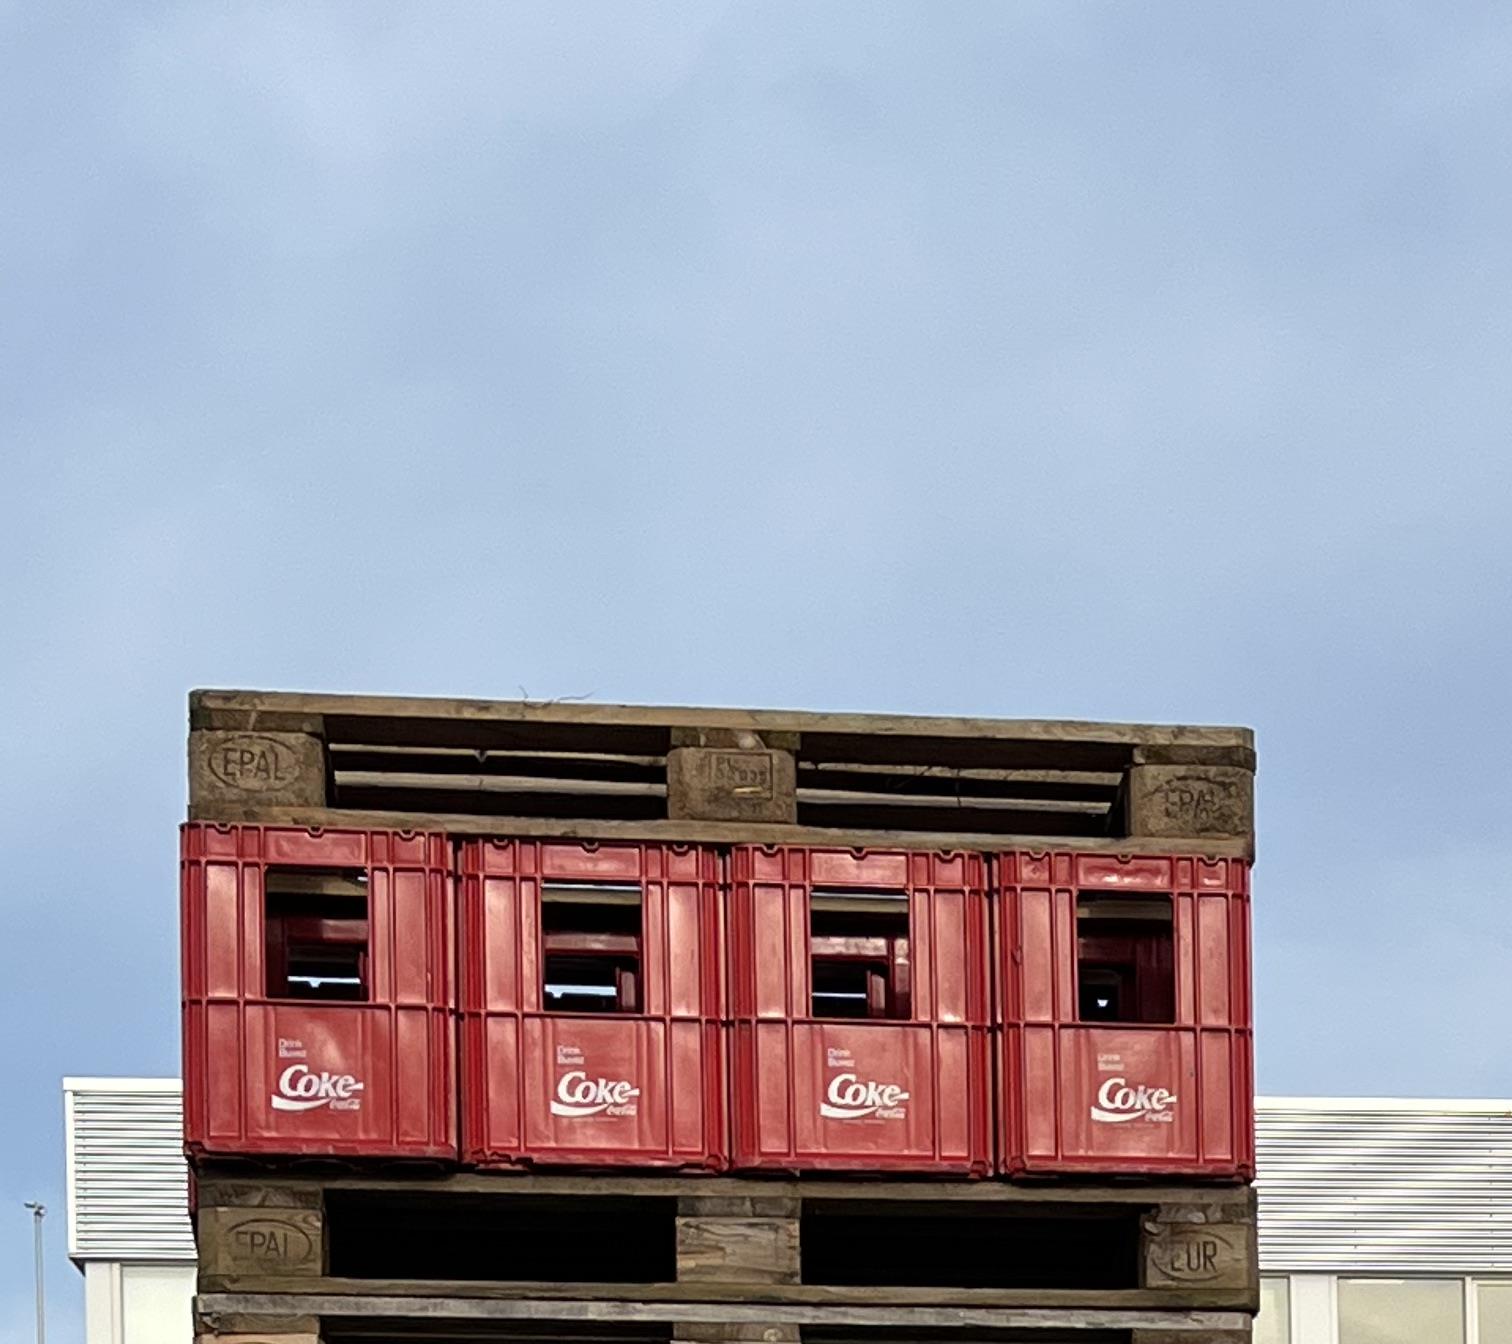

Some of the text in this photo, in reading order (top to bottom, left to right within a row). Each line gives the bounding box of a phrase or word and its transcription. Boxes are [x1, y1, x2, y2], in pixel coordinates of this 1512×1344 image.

[222, 745, 287, 780] EPAL
[279, 1063, 364, 1098] Coke
[557, 1070, 640, 1105] Coke
[827, 1073, 910, 1106] Coke
[1098, 1077, 1177, 1110] Coke
